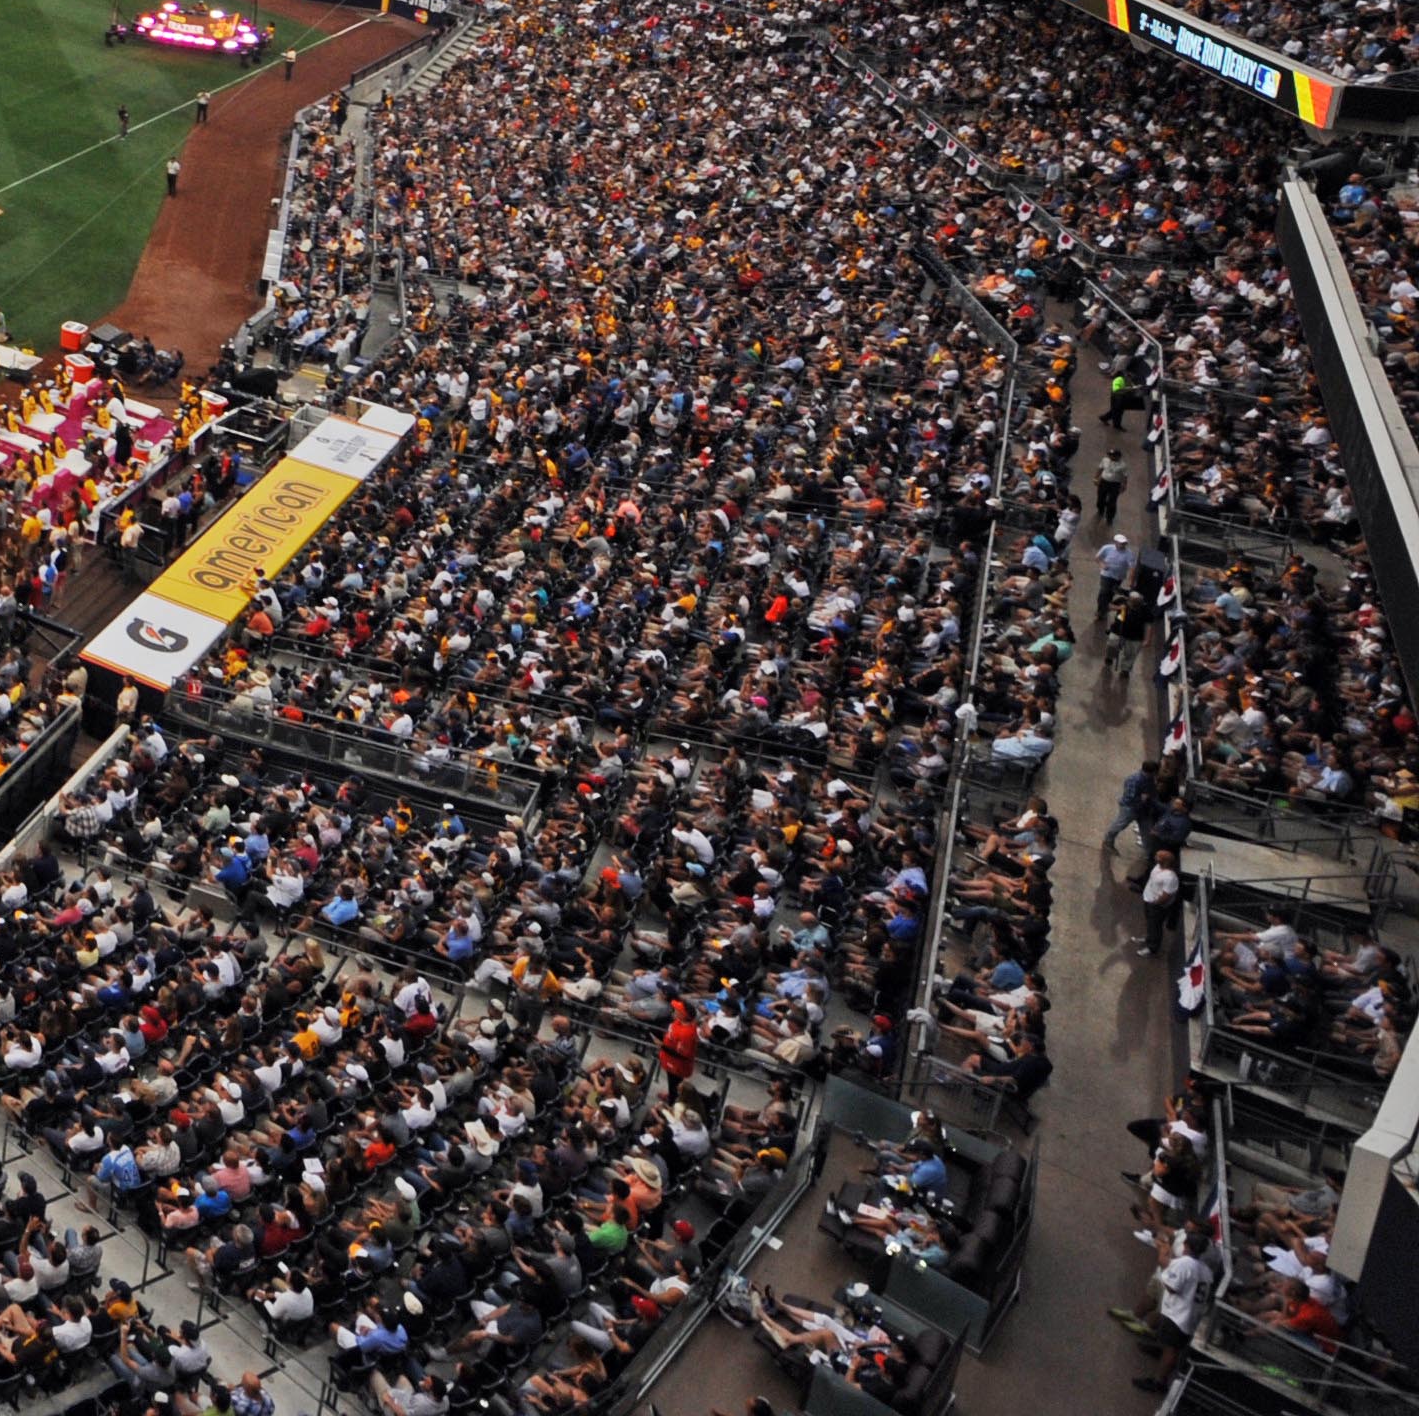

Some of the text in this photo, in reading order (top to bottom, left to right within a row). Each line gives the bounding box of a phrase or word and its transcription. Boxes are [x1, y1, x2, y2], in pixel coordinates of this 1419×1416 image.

[1175, 25, 1204, 62] HOME
[1201, 36, 1225, 71] RUN
[1220, 46, 1258, 87] DERBY
[194, 479, 327, 592] american
[125, 617, 189, 654] G
